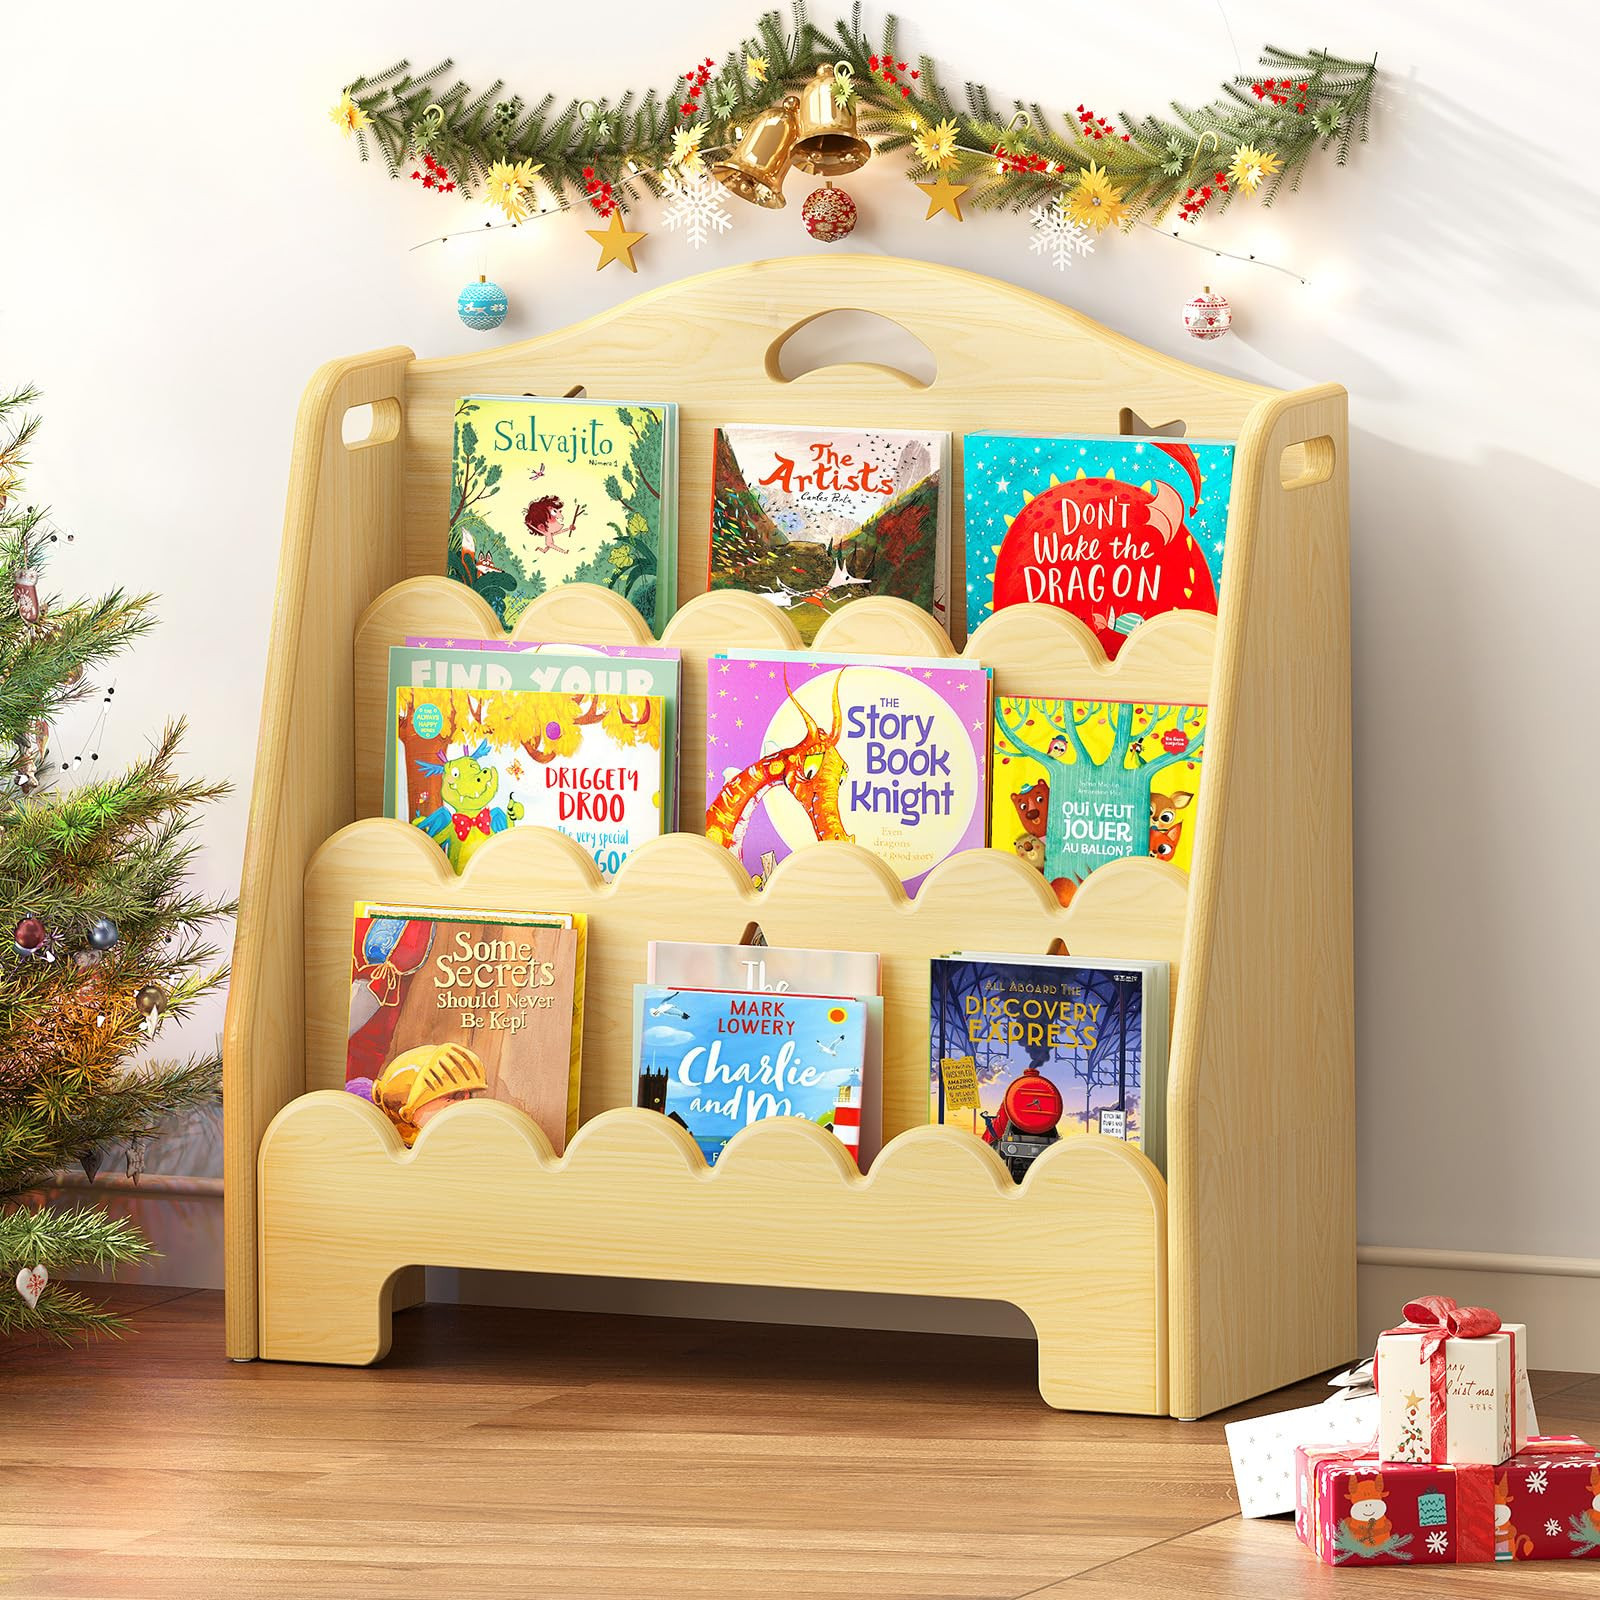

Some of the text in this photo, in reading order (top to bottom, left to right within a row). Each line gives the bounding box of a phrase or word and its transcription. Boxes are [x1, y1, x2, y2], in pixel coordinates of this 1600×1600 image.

[494, 415, 613, 463] Salvajito
[809, 442, 854, 468] The
[758, 452, 894, 495] Artists
[1061, 495, 1131, 536] DON'T
[1033, 531, 1155, 565] Wake the
[1023, 564, 1161, 604] DRAGON
[411, 659, 654, 695] FIND YOUR
[880, 697, 899, 708] THE
[847, 704, 935, 747] Story
[866, 741, 951, 776] Book
[545, 767, 639, 791] DRIGGETY
[559, 791, 625, 823] DROO
[851, 779, 955, 826] Knight
[1093, 803, 1135, 819] VEUT
[576, 832, 596, 847] very
[599, 829, 629, 848] special
[1062, 842, 1079, 854] AU
[1081, 843, 1124, 857] BALLON
[452, 931, 533, 963] Some
[433, 954, 556, 989] Secrets
[436, 990, 555, 1009] Should Never
[730, 1000, 786, 1018] MARK
[965, 995, 1101, 1023] DISCOVERY
[460, 1010, 528, 1035] Be Kept
[717, 1018, 796, 1036] LOWERY
[967, 1018, 1099, 1051] EXPRESS
[678, 1040, 827, 1092] Charlie
[689, 1085, 744, 1121] and
